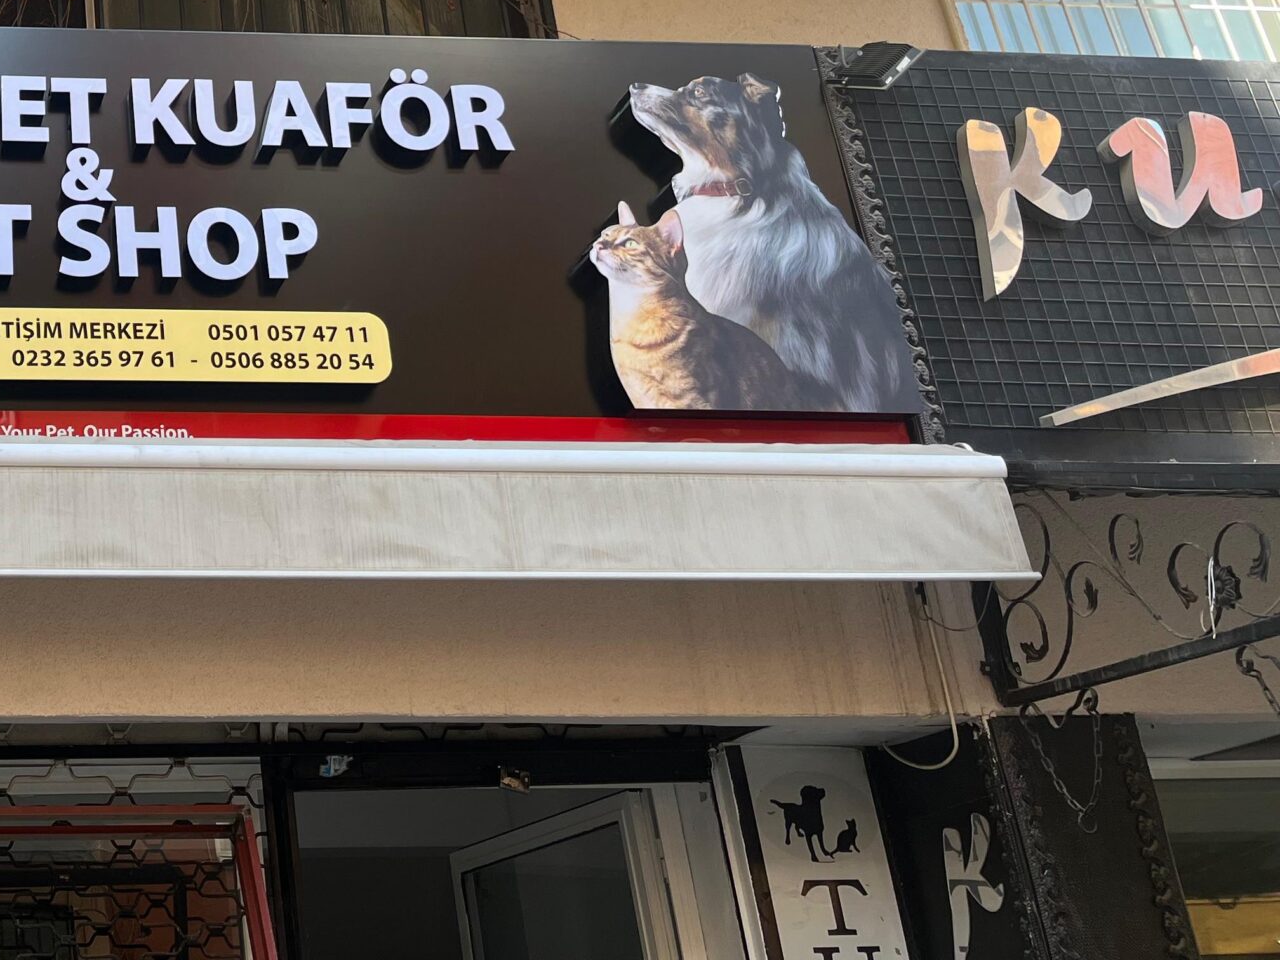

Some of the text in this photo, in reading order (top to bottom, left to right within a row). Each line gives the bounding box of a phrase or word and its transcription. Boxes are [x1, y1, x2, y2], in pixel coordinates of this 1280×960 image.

[131, 68, 516, 152] KUAFÖR
[61, 147, 117, 202] &
[58, 205, 319, 281] SHOP
[69, 319, 166, 340] MERKEZİ
[208, 324, 259, 341] 0501
[267, 324, 306, 342] 057
[313, 325, 338, 342] 47
[345, 326, 369, 343] 11
[11, 349, 66, 367] 0232
[72, 350, 112, 368] 365
[118, 350, 144, 368] 97
[151, 350, 175, 368] 61
[210, 351, 265, 369] 0506
[270, 352, 310, 370] 885
[315, 353, 342, 370] 20
[349, 353, 375, 371] 54
[0, 424, 41, 437] Your
[83, 424, 117, 438] Our
[800, 878, 881, 960] T
